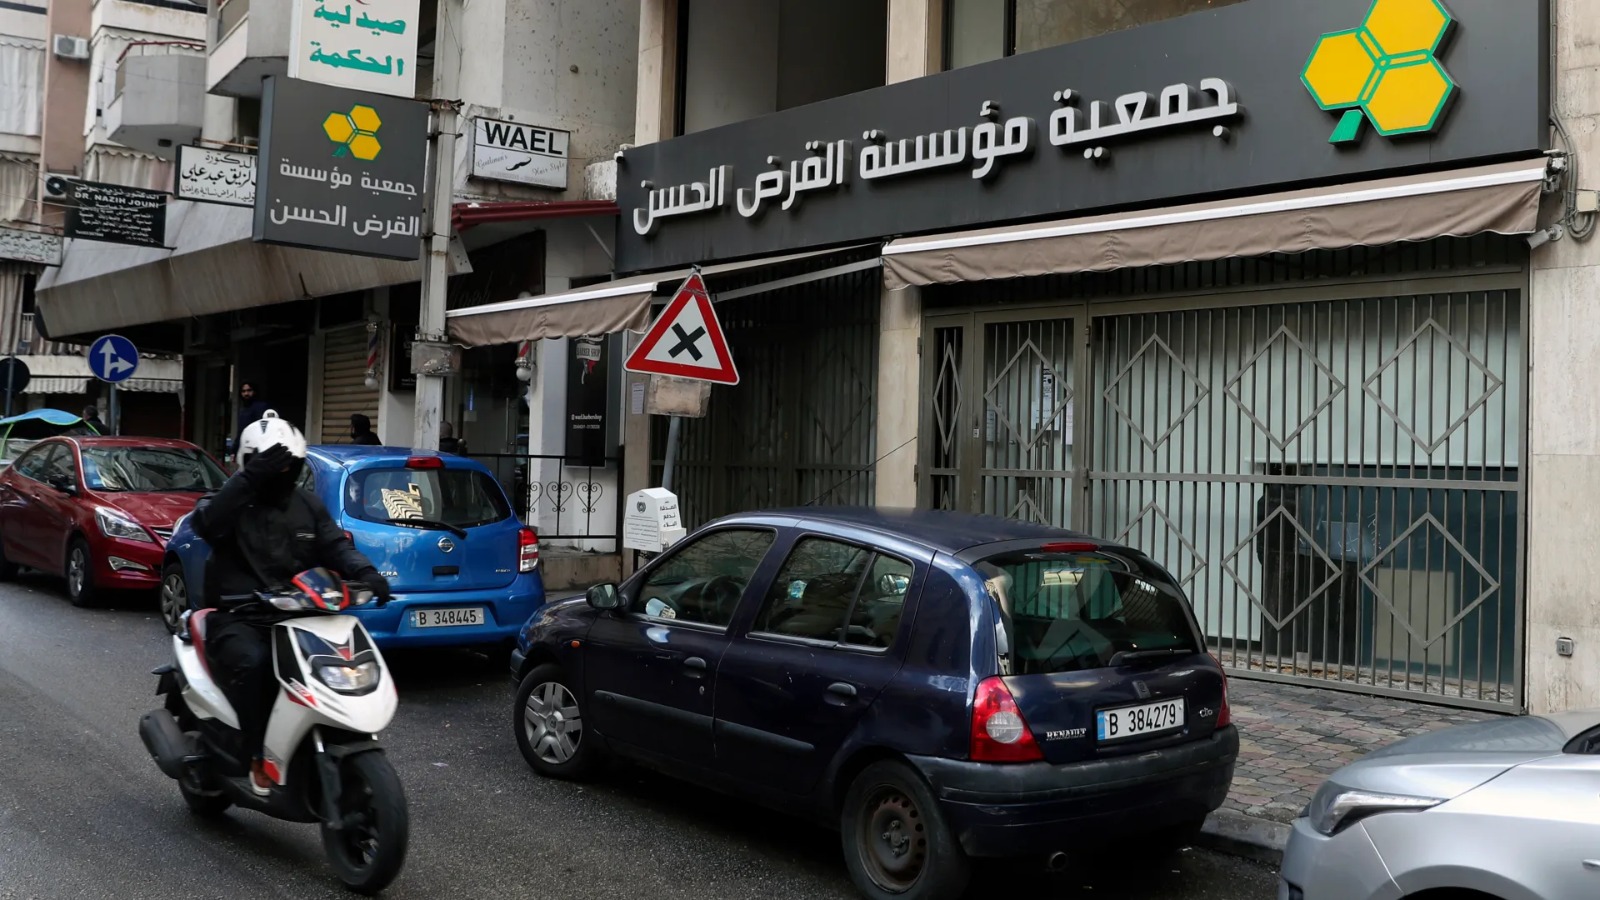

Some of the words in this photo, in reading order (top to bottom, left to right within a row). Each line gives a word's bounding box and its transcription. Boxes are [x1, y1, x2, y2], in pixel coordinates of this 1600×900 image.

[313, 0, 406, 36] صيدلية
[309, 41, 404, 76] الحكمة
[1050, 77, 1238, 159] جمعية
[484, 121, 562, 155] WAEL
[860, 100, 1029, 179] مؤسسة
[280, 158, 352, 189] مؤسسة
[361, 171, 417, 200] جمعية
[737, 139, 844, 217] القرض
[94, 194, 126, 204] NAZIH
[127, 199, 159, 208] JOUNI
[270, 198, 347, 227] الحسن
[633, 165, 726, 235] الحسن
[353, 214, 420, 239] القرض
[419, 611, 427, 626] B
[434, 609, 477, 625] 348445
[1046, 727, 1087, 739] RENAULT
[1109, 712, 1119, 736] B
[1128, 703, 1177, 733] 384279
